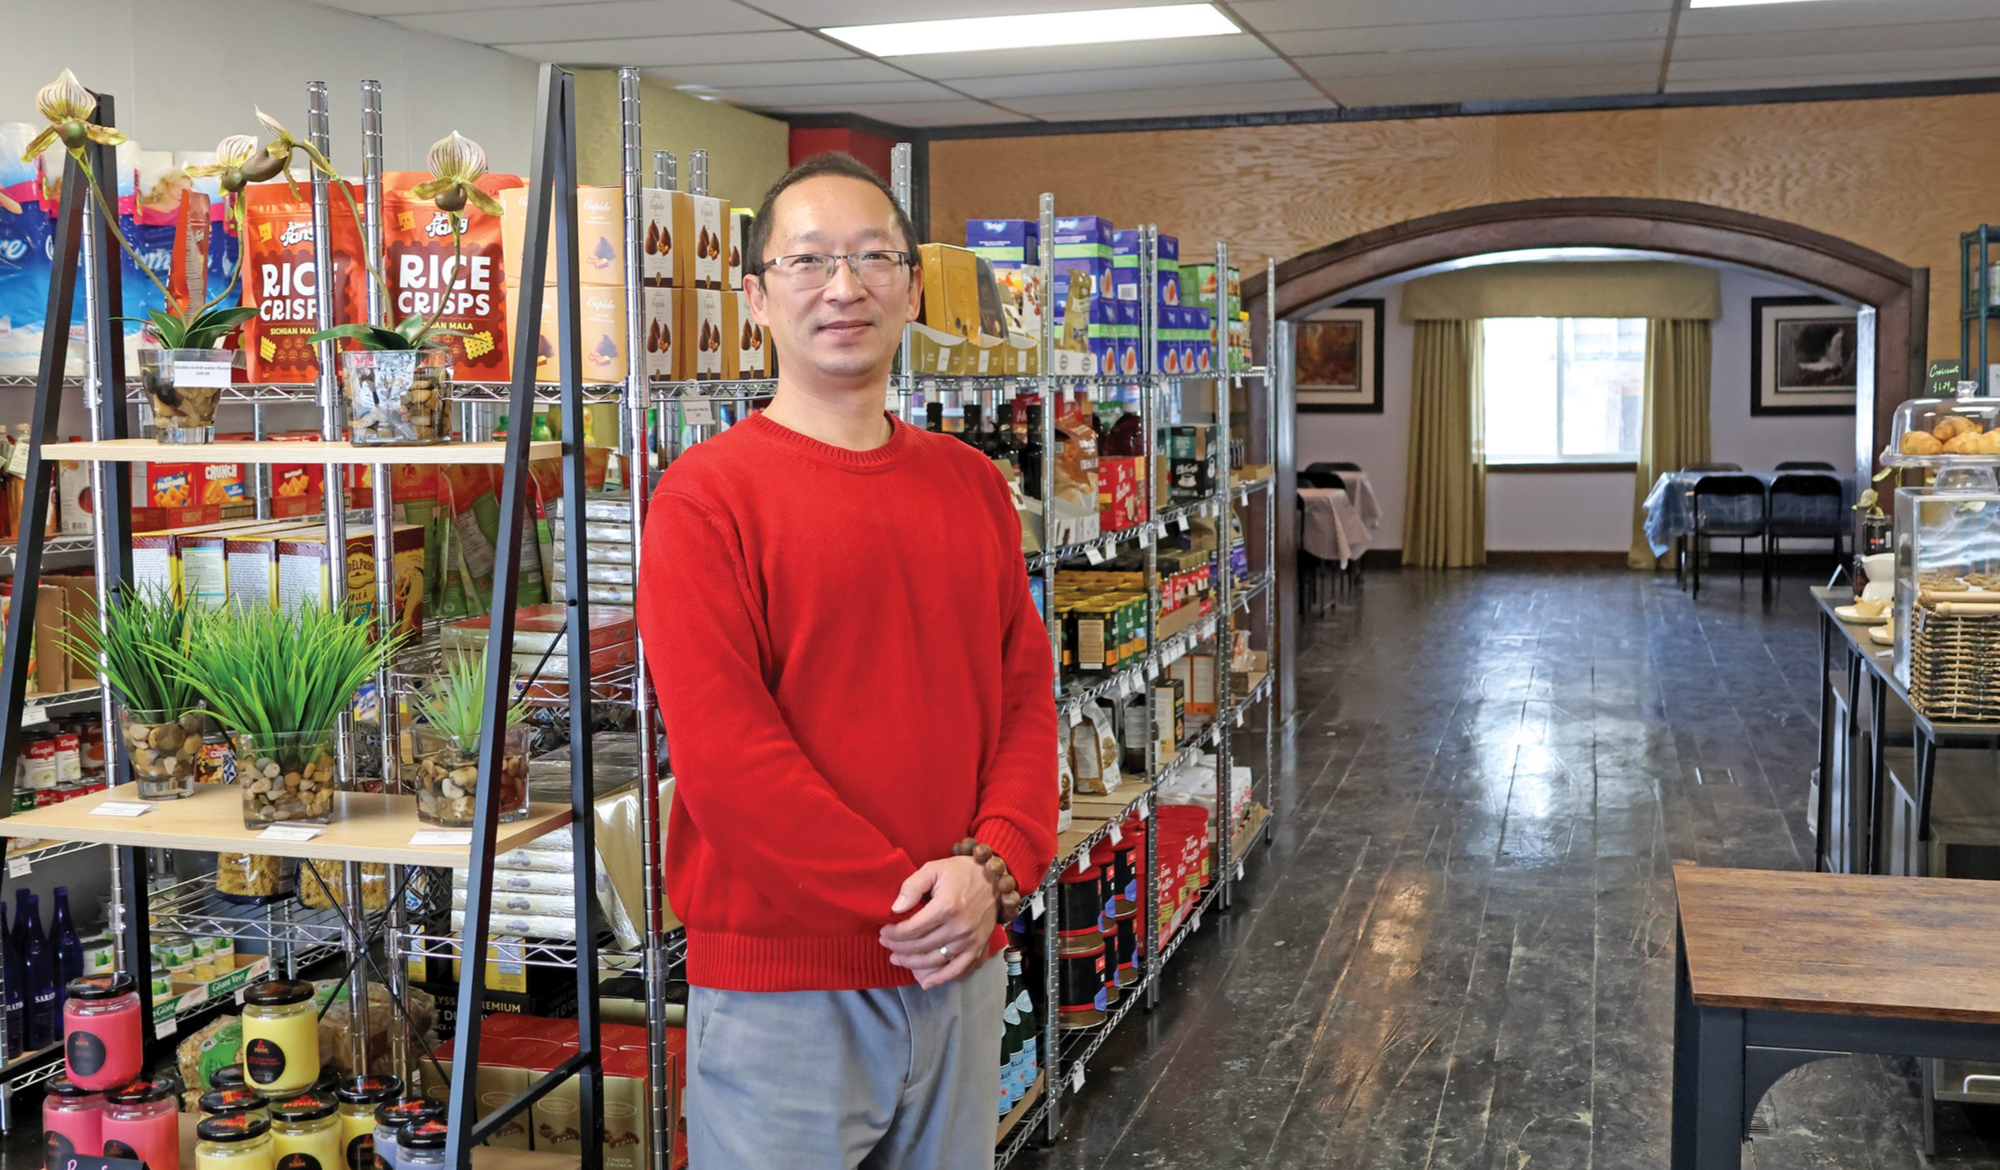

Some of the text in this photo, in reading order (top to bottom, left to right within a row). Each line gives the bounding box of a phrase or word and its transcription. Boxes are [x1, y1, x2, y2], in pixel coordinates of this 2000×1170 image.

[262, 262, 338, 297] RIC
[399, 254, 491, 291] RICE
[259, 299, 318, 321] CRISP
[398, 291, 490, 316] CRISPS
[450, 322, 474, 330] MALA
[205, 464, 238, 480] CRUNCH
[482, 1001, 521, 1013] REMIUM
